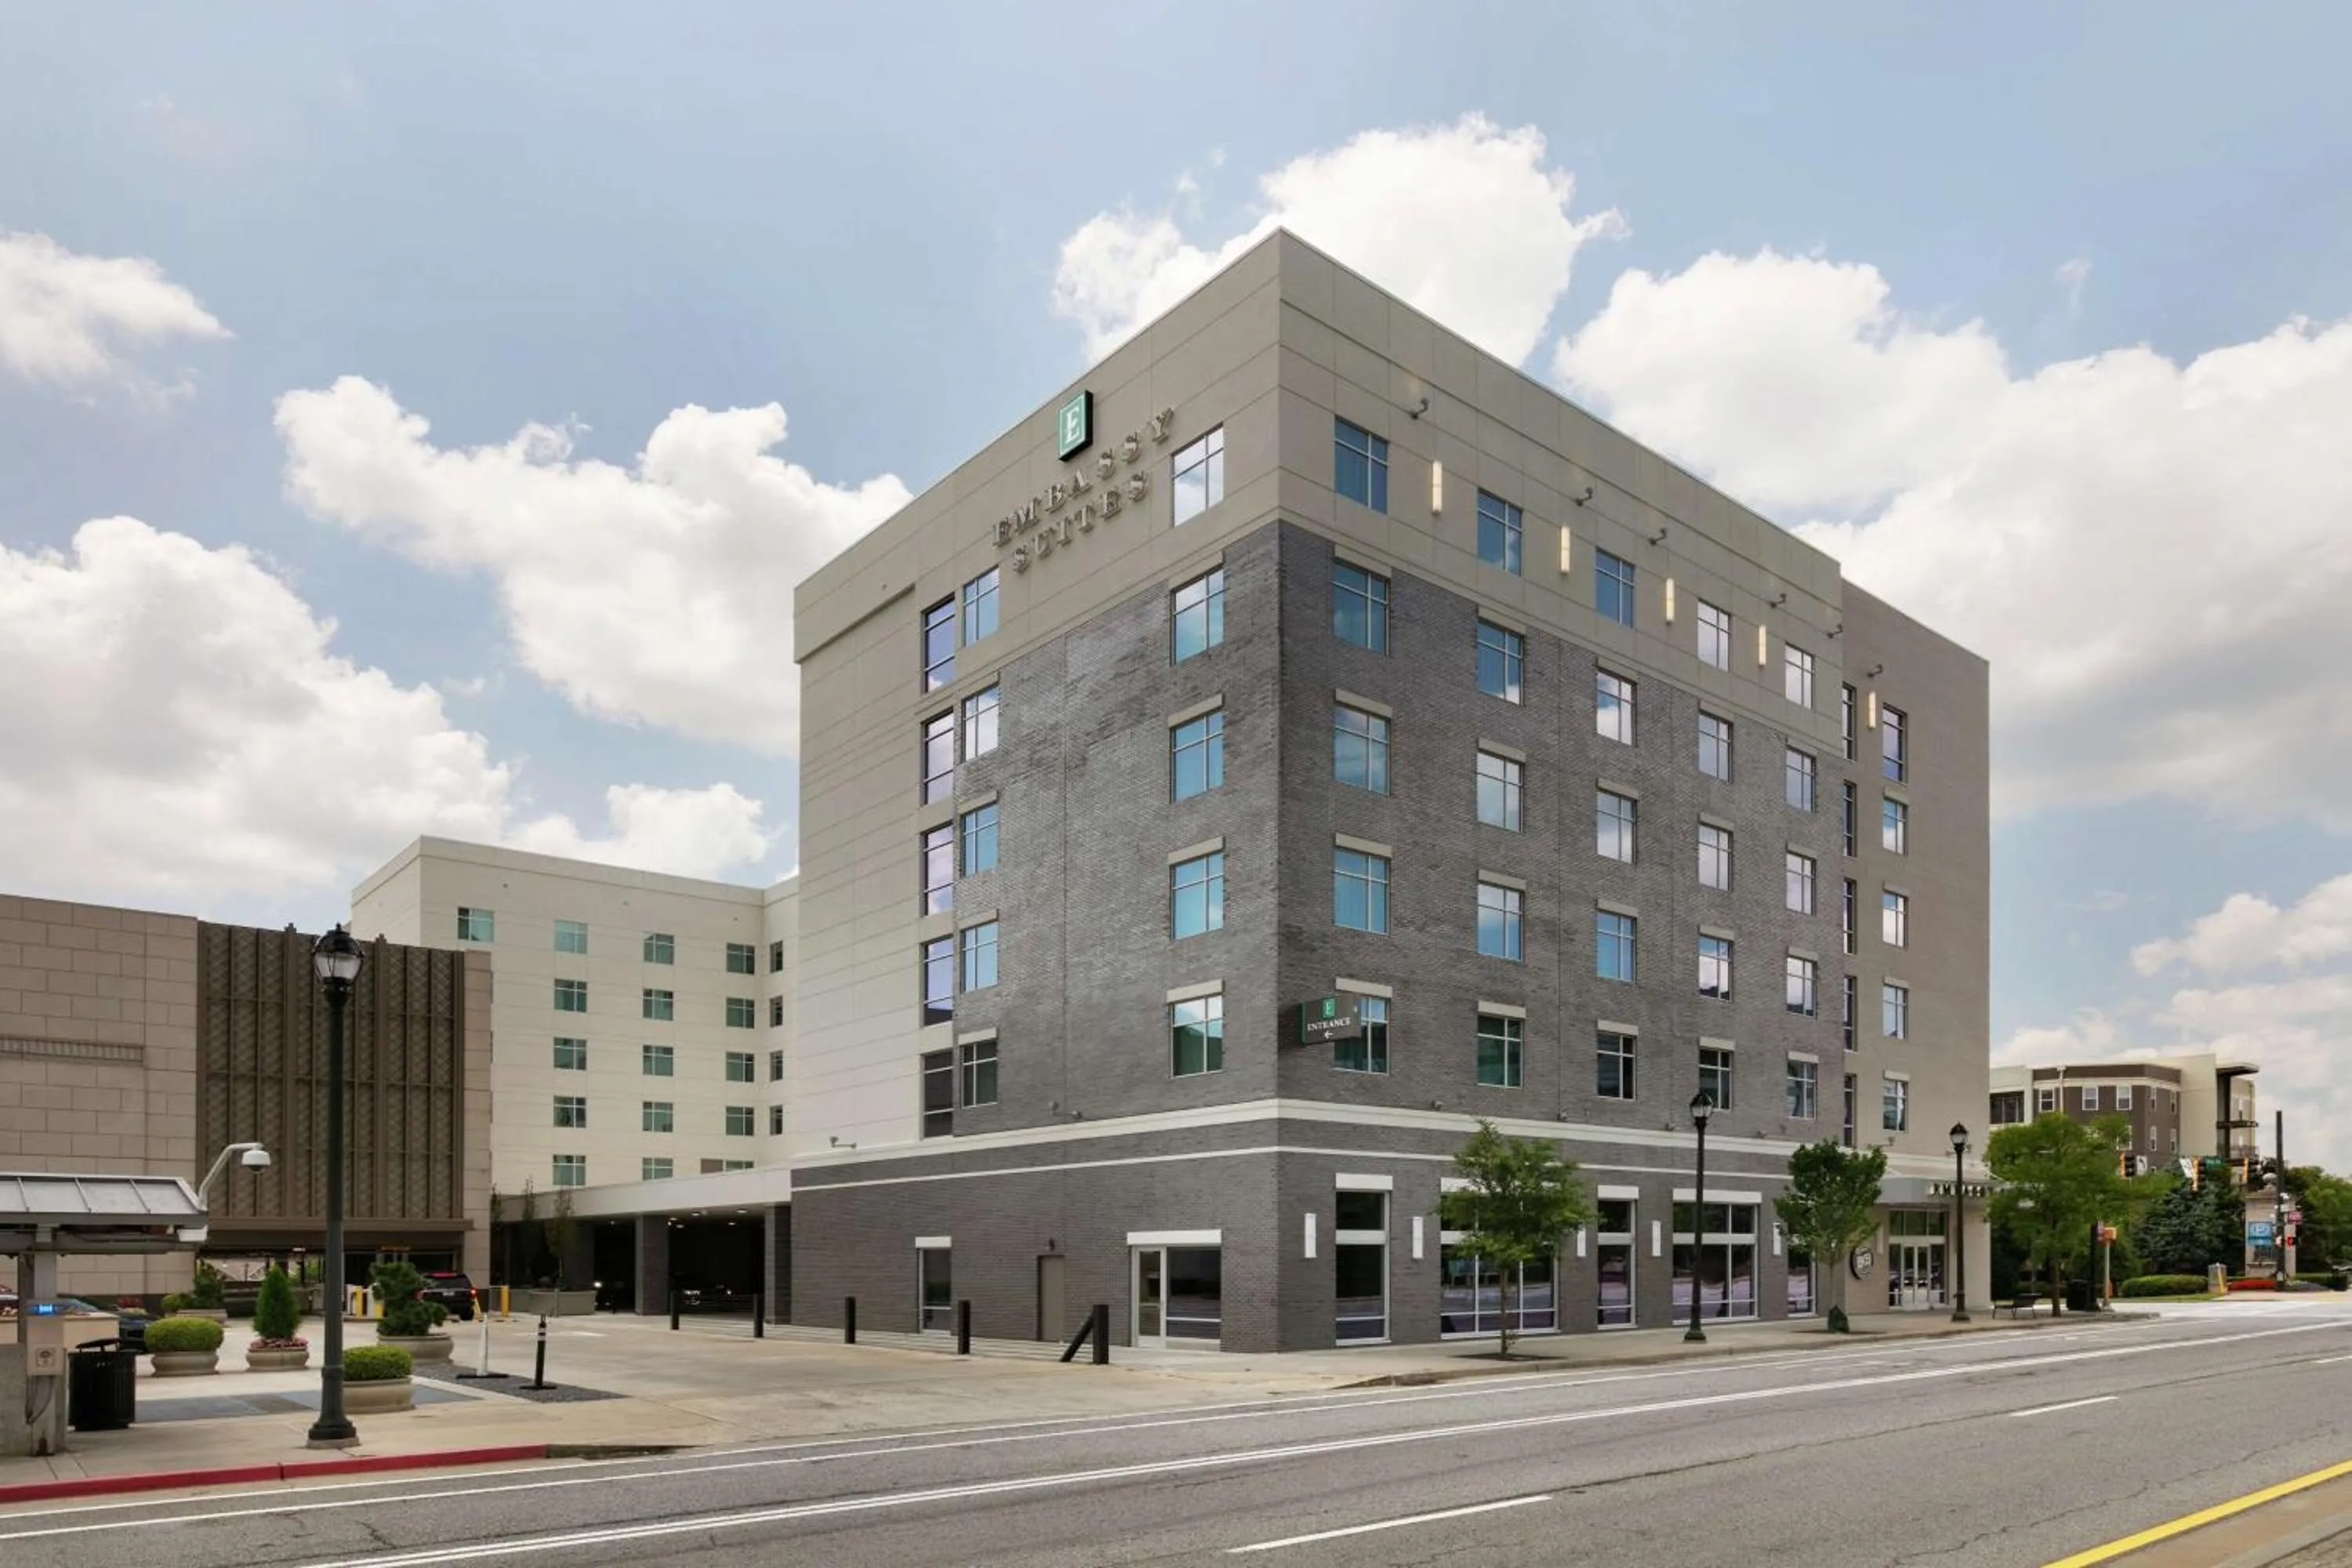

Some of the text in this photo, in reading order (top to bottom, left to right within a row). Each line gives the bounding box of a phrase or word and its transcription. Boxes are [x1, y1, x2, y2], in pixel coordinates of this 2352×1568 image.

[1065, 406, 1080, 445] E
[992, 407, 1174, 548] EMBASSY
[1012, 470, 1147, 574] SUITES
[1307, 1017, 1350, 1032] ENTRANCE
